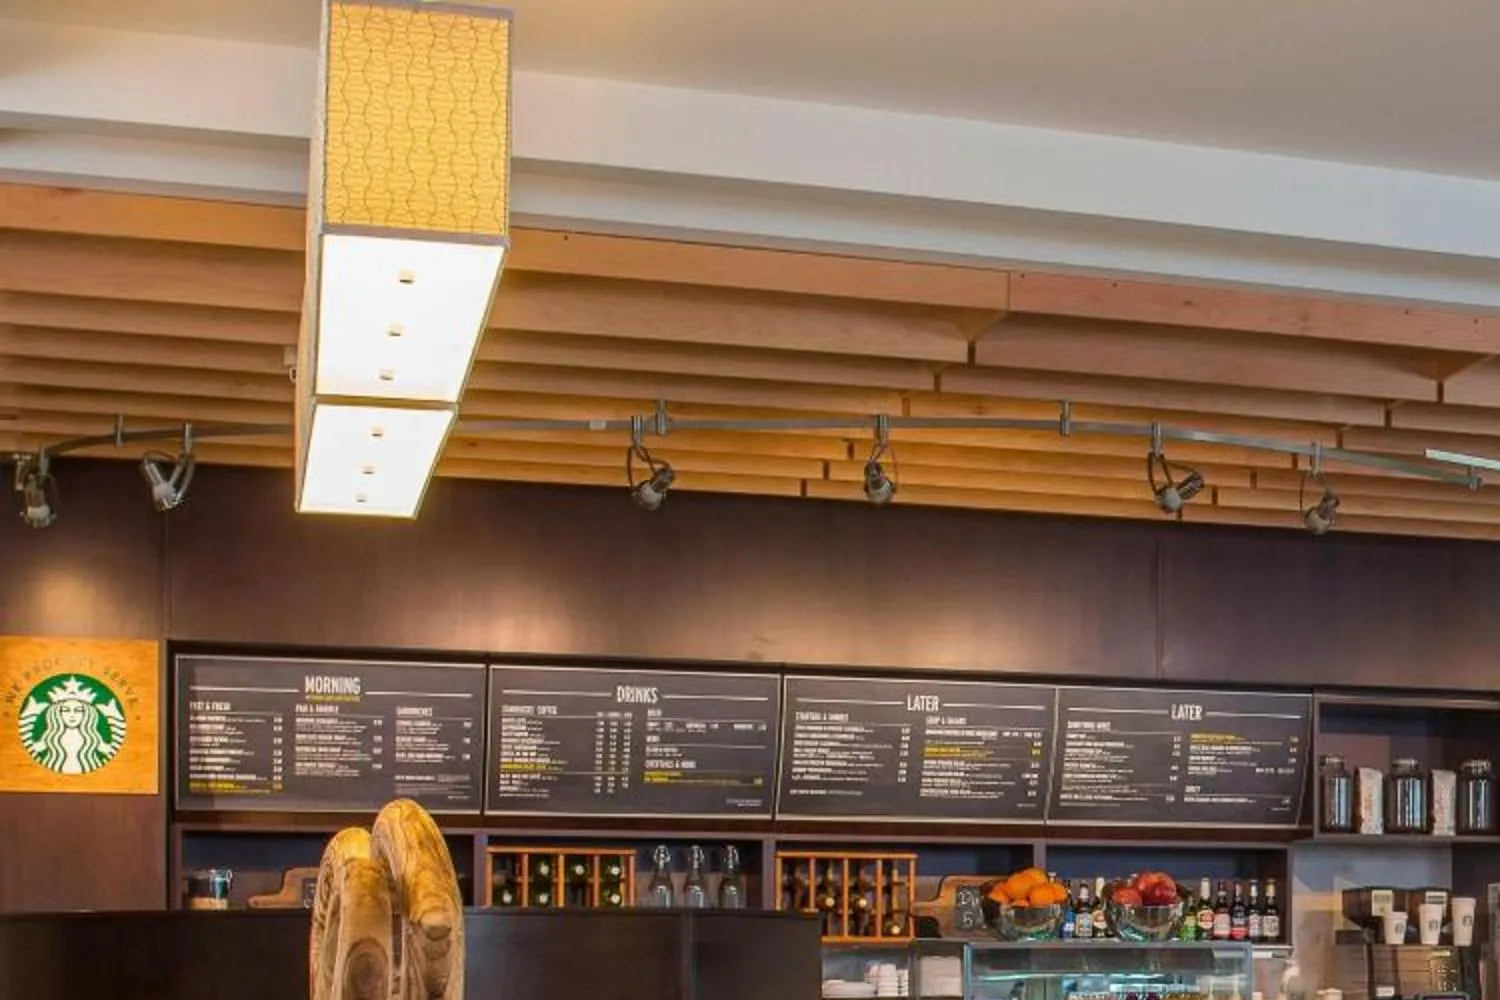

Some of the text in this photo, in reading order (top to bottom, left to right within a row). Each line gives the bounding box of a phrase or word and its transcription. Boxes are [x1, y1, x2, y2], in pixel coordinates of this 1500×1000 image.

[304, 675, 361, 695] MORNING
[616, 685, 658, 704] DRINKS
[907, 695, 940, 712] LATER
[1171, 704, 1203, 720] LATER
